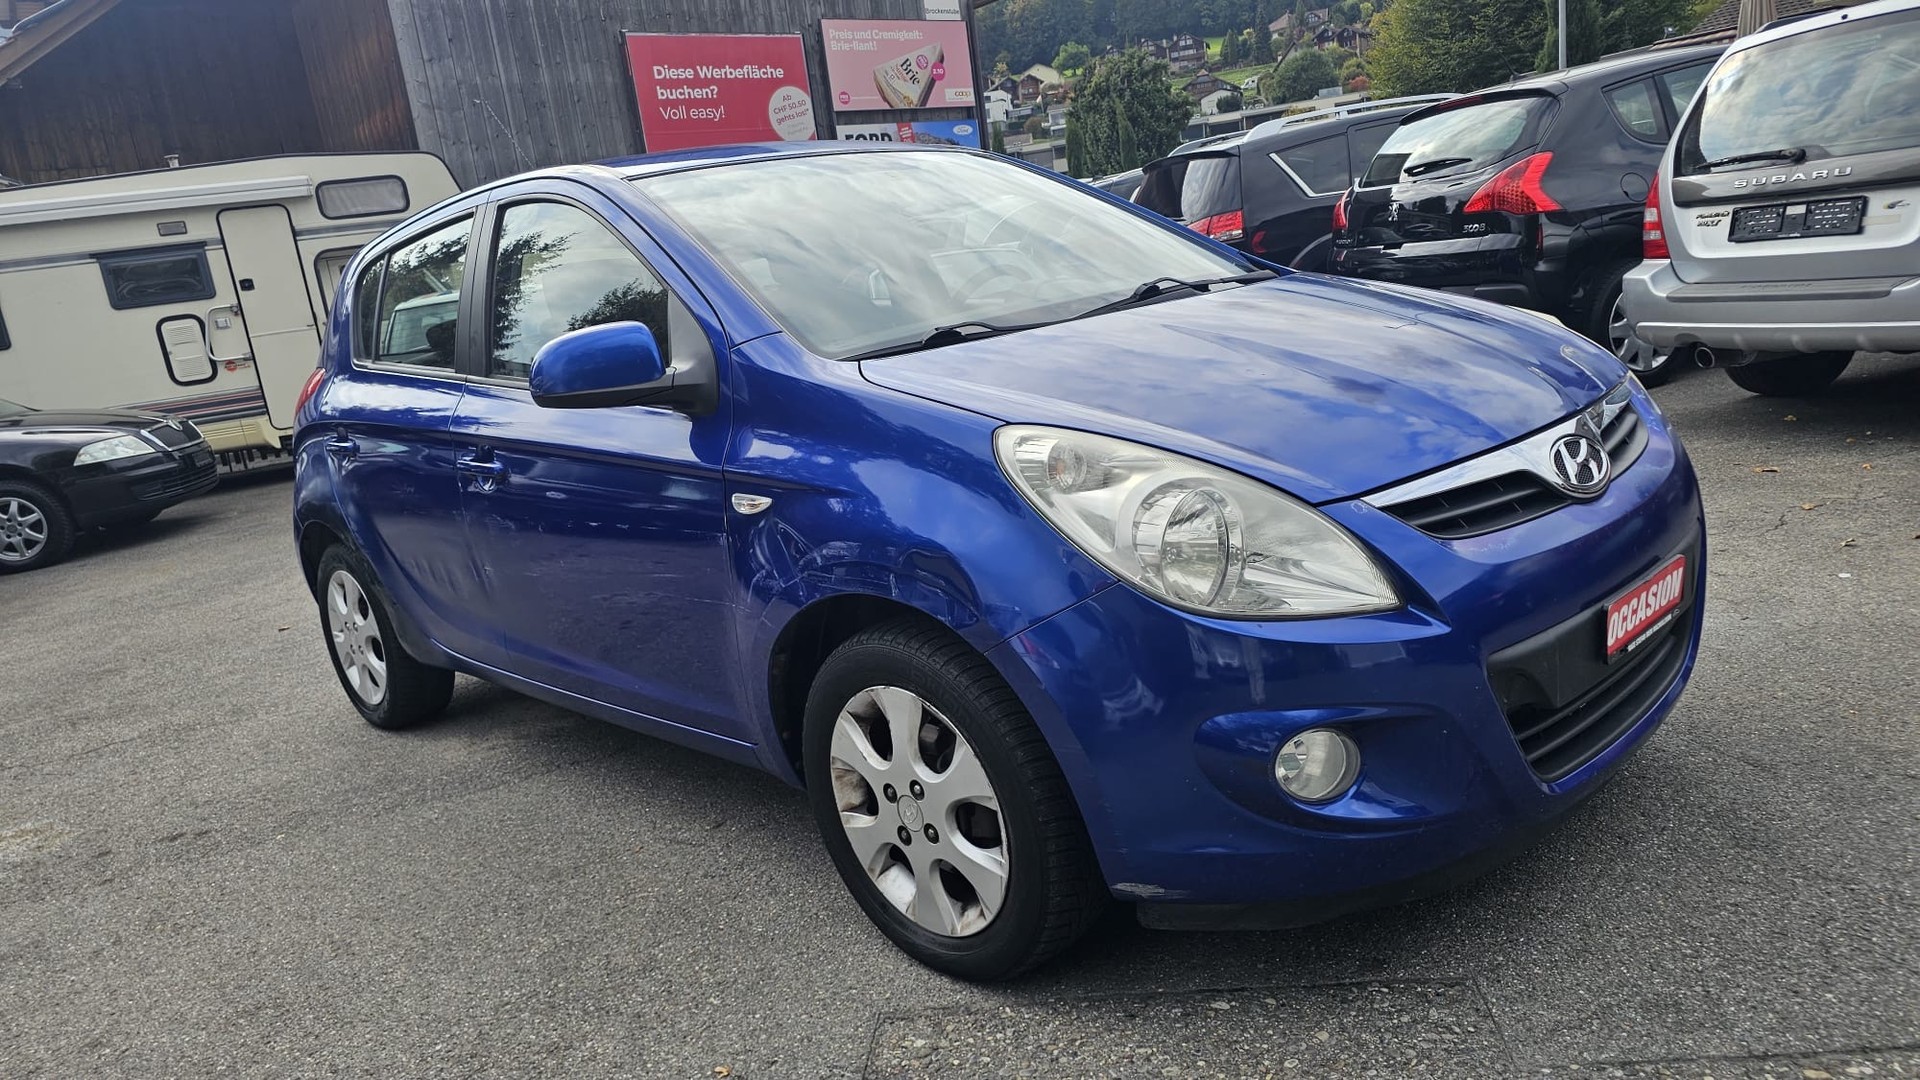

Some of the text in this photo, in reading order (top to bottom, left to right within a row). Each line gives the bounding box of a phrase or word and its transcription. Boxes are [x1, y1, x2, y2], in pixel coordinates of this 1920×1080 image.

[829, 28, 923, 41] Preis und Cremigkeit:
[831, 41, 877, 51] Brie-liant!
[653, 64, 784, 79] Diese Werbefläche
[900, 57, 920, 84] Brie
[656, 85, 718, 99] buchen?
[782, 93, 791, 102] Ab
[660, 105, 726, 121] Voll easy!
[773, 99, 807, 115] CHF 50.50
[776, 112, 795, 126] gehts
[1733, 166, 1852, 189] SUBARU
[1462, 222, 1486, 233] 3008
[1606, 566, 1684, 647] OCCASION
